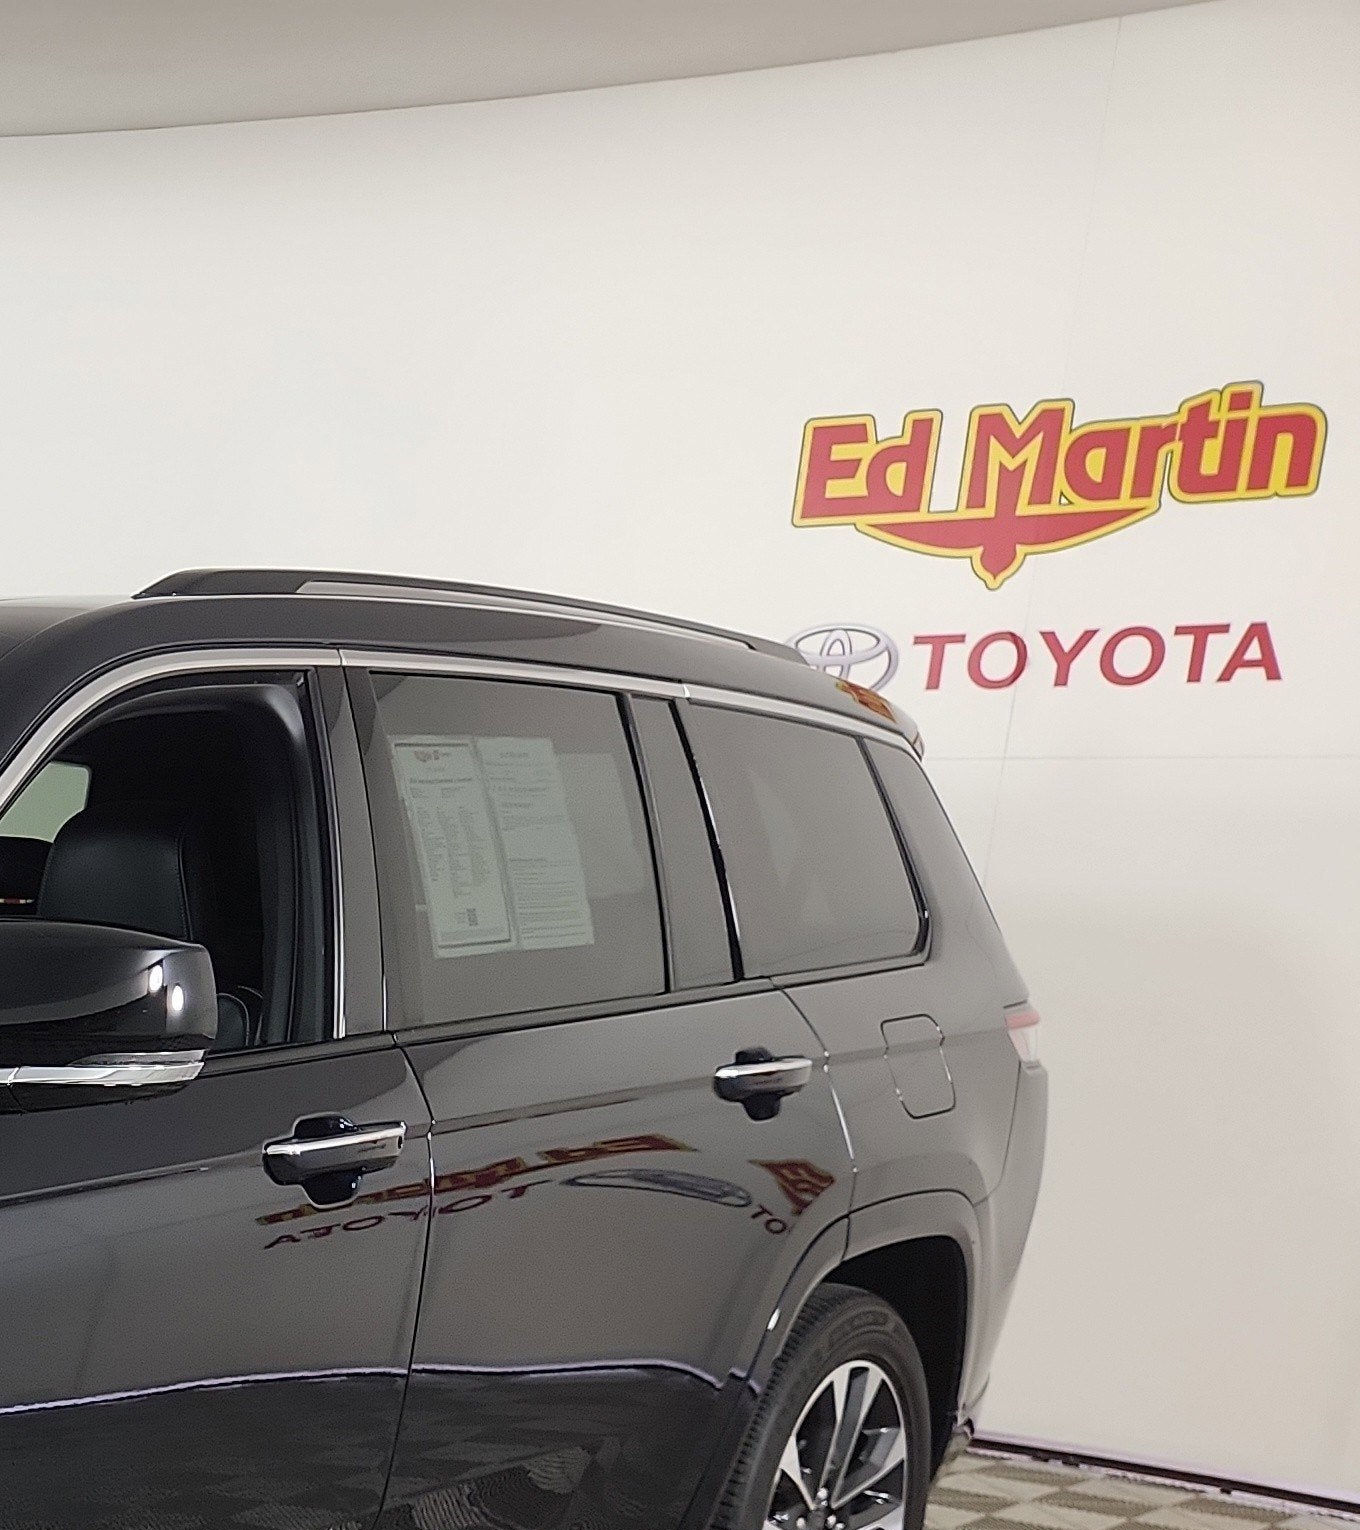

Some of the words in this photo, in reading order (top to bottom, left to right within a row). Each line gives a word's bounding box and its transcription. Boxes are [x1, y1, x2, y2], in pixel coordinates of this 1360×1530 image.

[796, 412, 937, 522] Ed
[962, 386, 1322, 512] Martin
[912, 620, 1283, 692] TOYOTA
